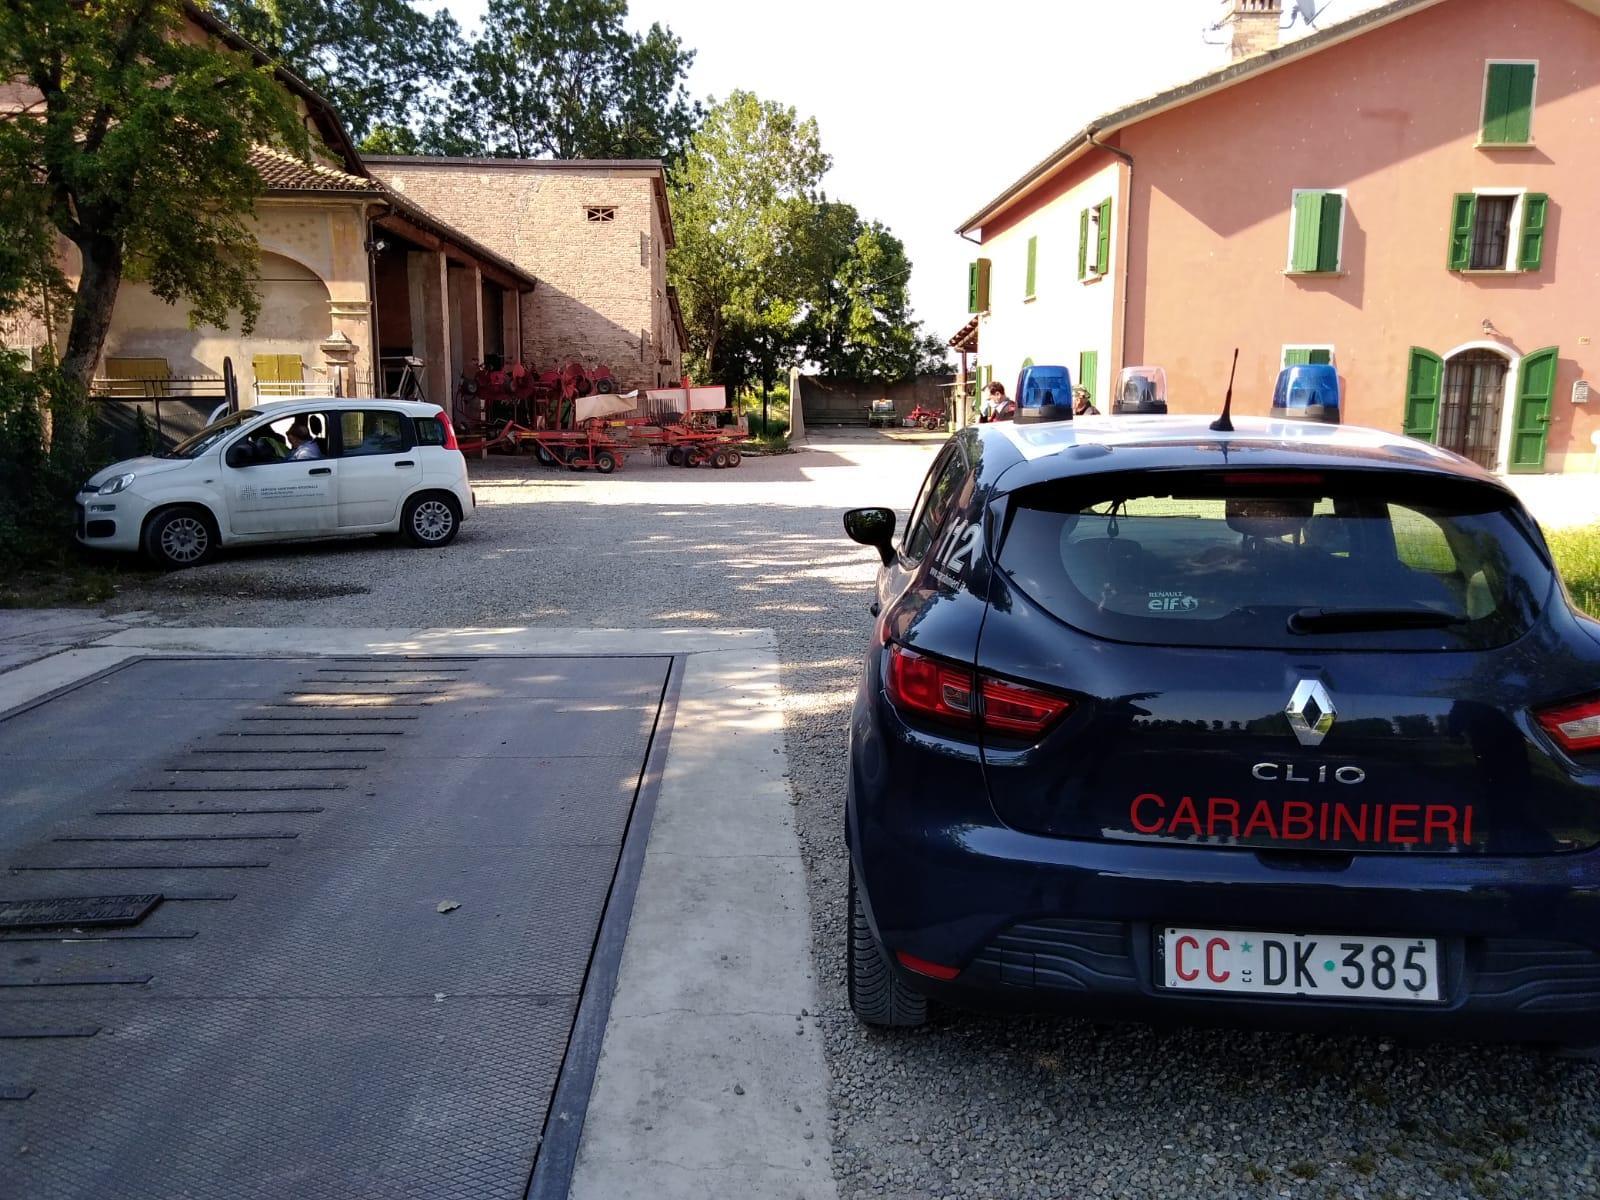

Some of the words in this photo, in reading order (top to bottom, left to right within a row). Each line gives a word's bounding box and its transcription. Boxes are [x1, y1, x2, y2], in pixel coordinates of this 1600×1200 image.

[934, 516, 980, 573] 112
[1148, 598, 1179, 610] elf
[1251, 762, 1366, 785] CLIO
[1130, 794, 1473, 845] CARABINIERI
[1175, 935, 1231, 983] CC
[1262, 939, 1318, 988] DK
[1340, 943, 1427, 992] 385
